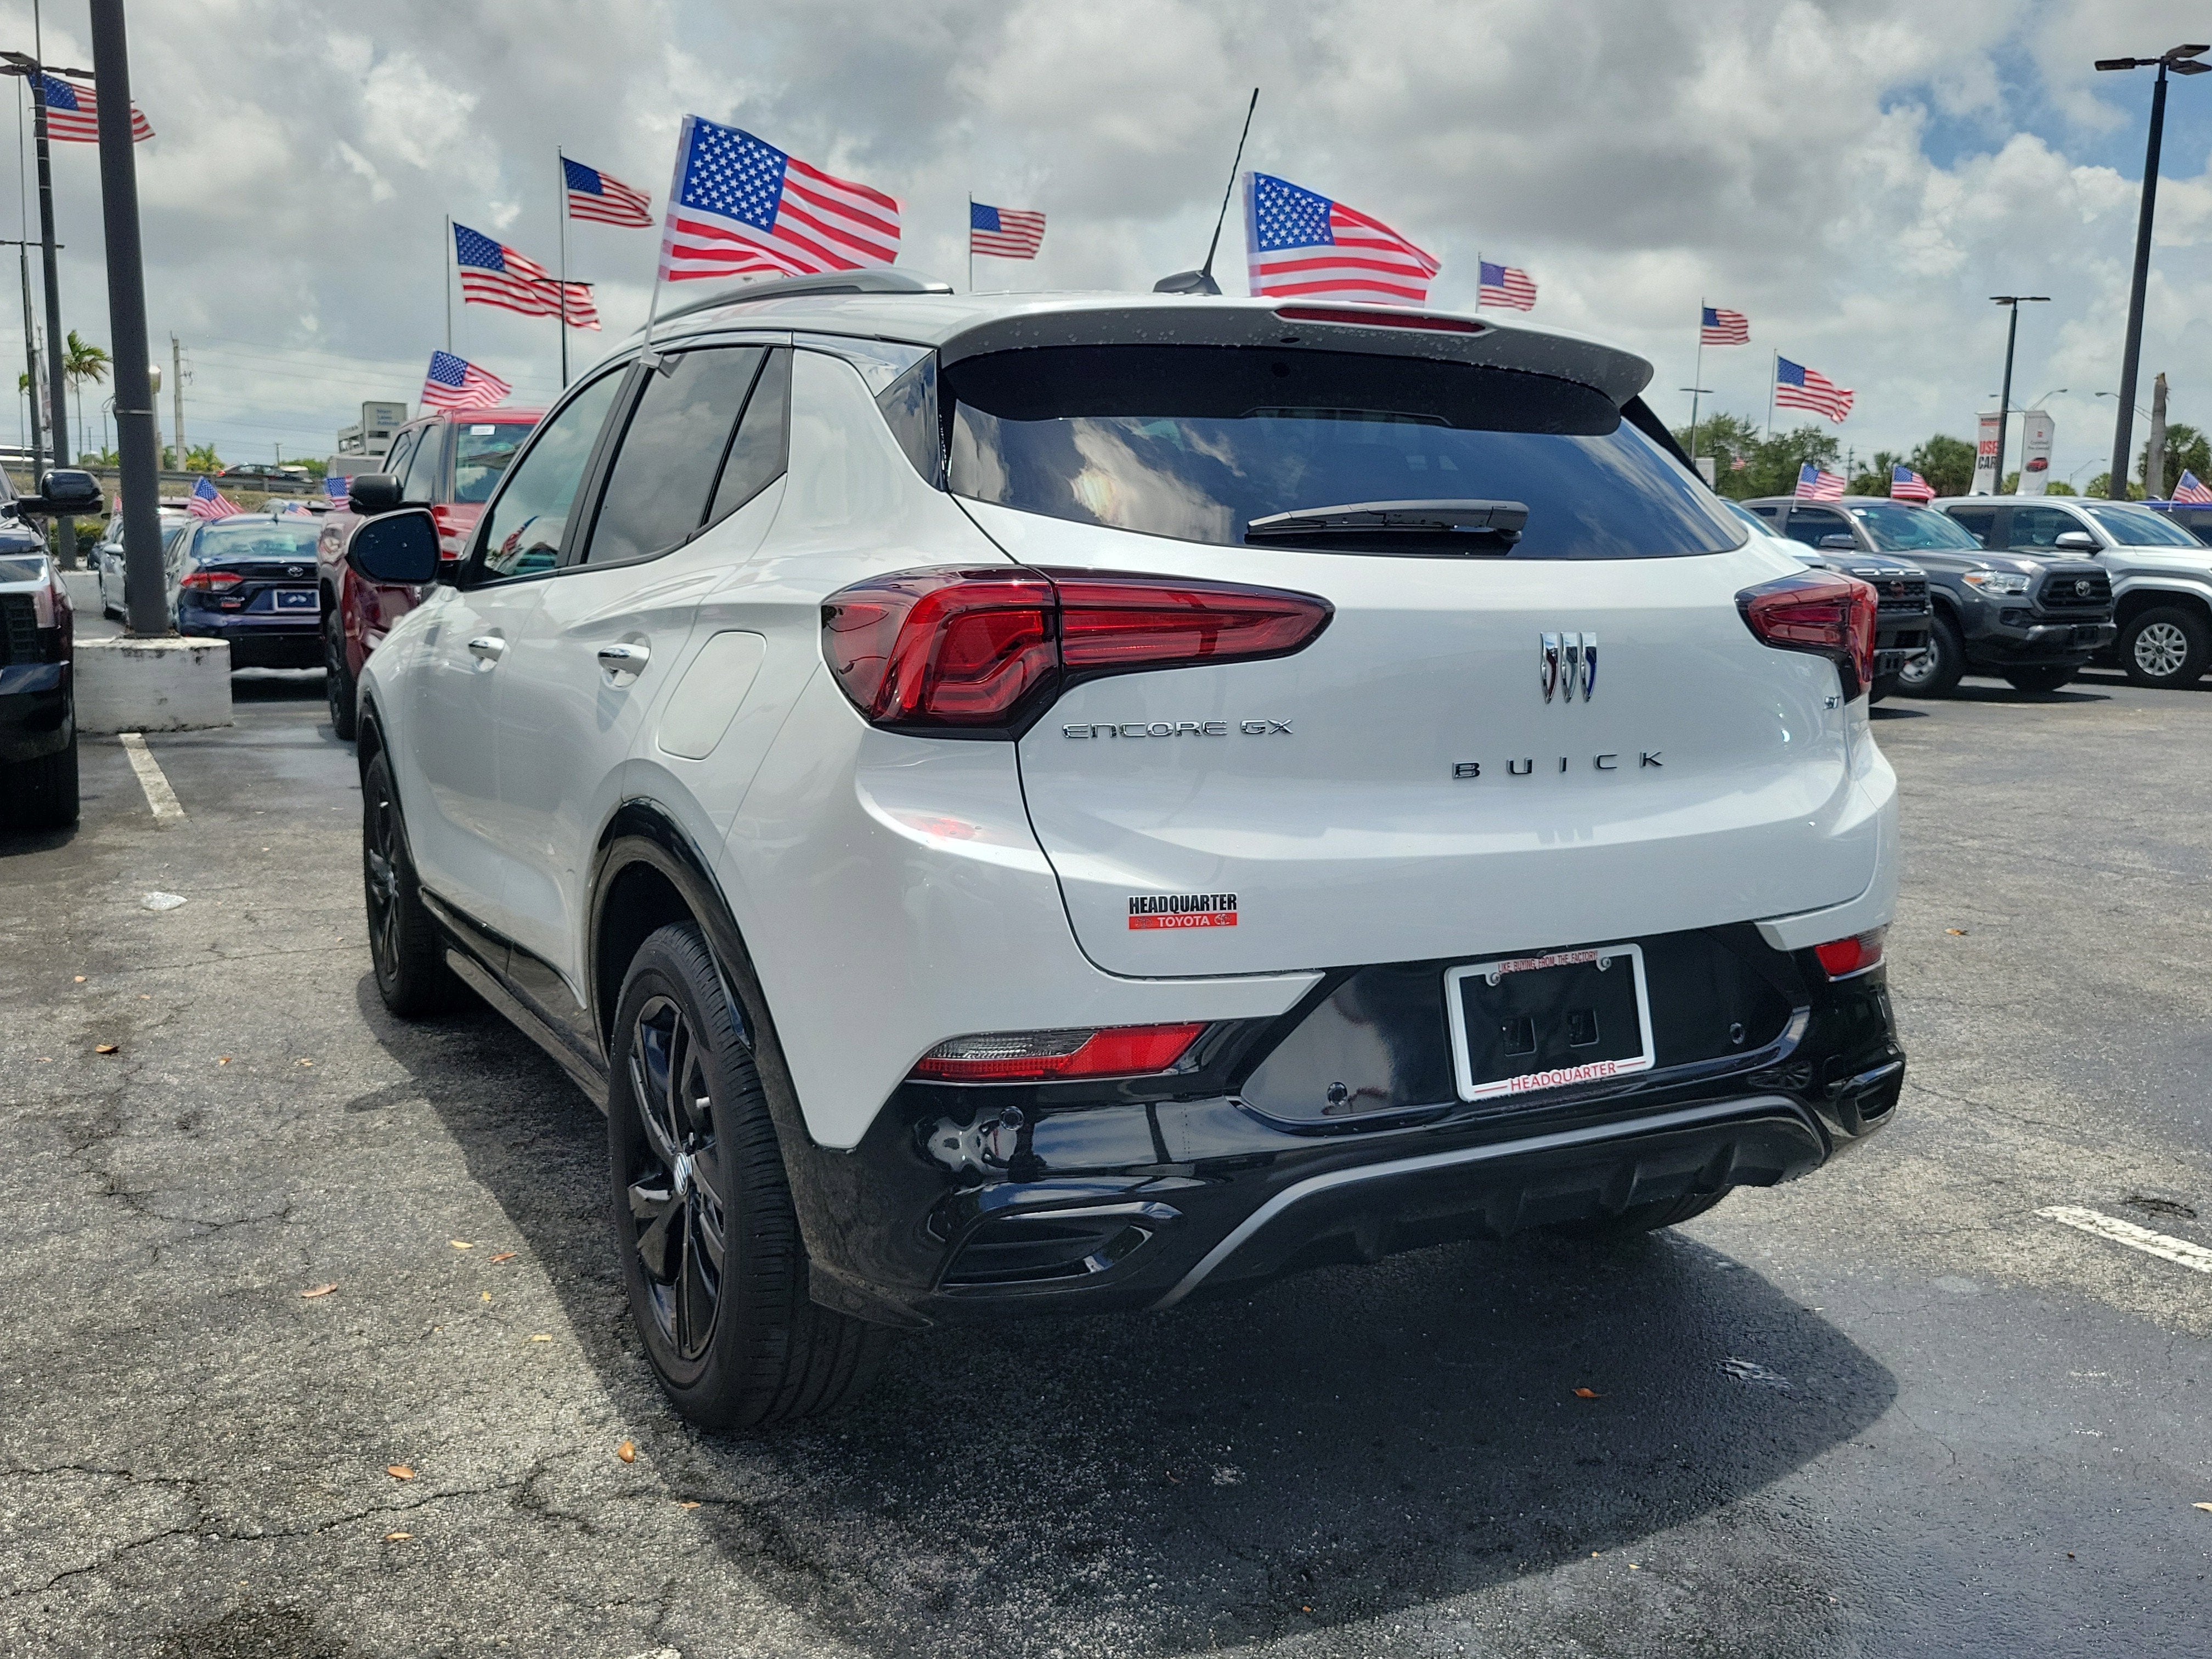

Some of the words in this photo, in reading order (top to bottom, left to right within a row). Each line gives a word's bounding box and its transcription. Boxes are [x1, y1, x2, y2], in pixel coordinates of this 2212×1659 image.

[1979, 441, 1999, 454] USE
[1978, 456, 1997, 469] CAR
[1062, 720, 1227, 738] ENCORE
[1239, 719, 1293, 735] GX
[1452, 751, 1663, 779] BUICK
[1128, 893, 1237, 915] HEADQUARTER
[1157, 916, 1210, 928] TOYOTA
[1498, 962, 1510, 973] LIKE
[1514, 958, 1536, 970] BUYING
[1538, 956, 1555, 967] FROM
[1558, 954, 1568, 964] THE
[1510, 1062, 1616, 1091] HEADQUARTER
